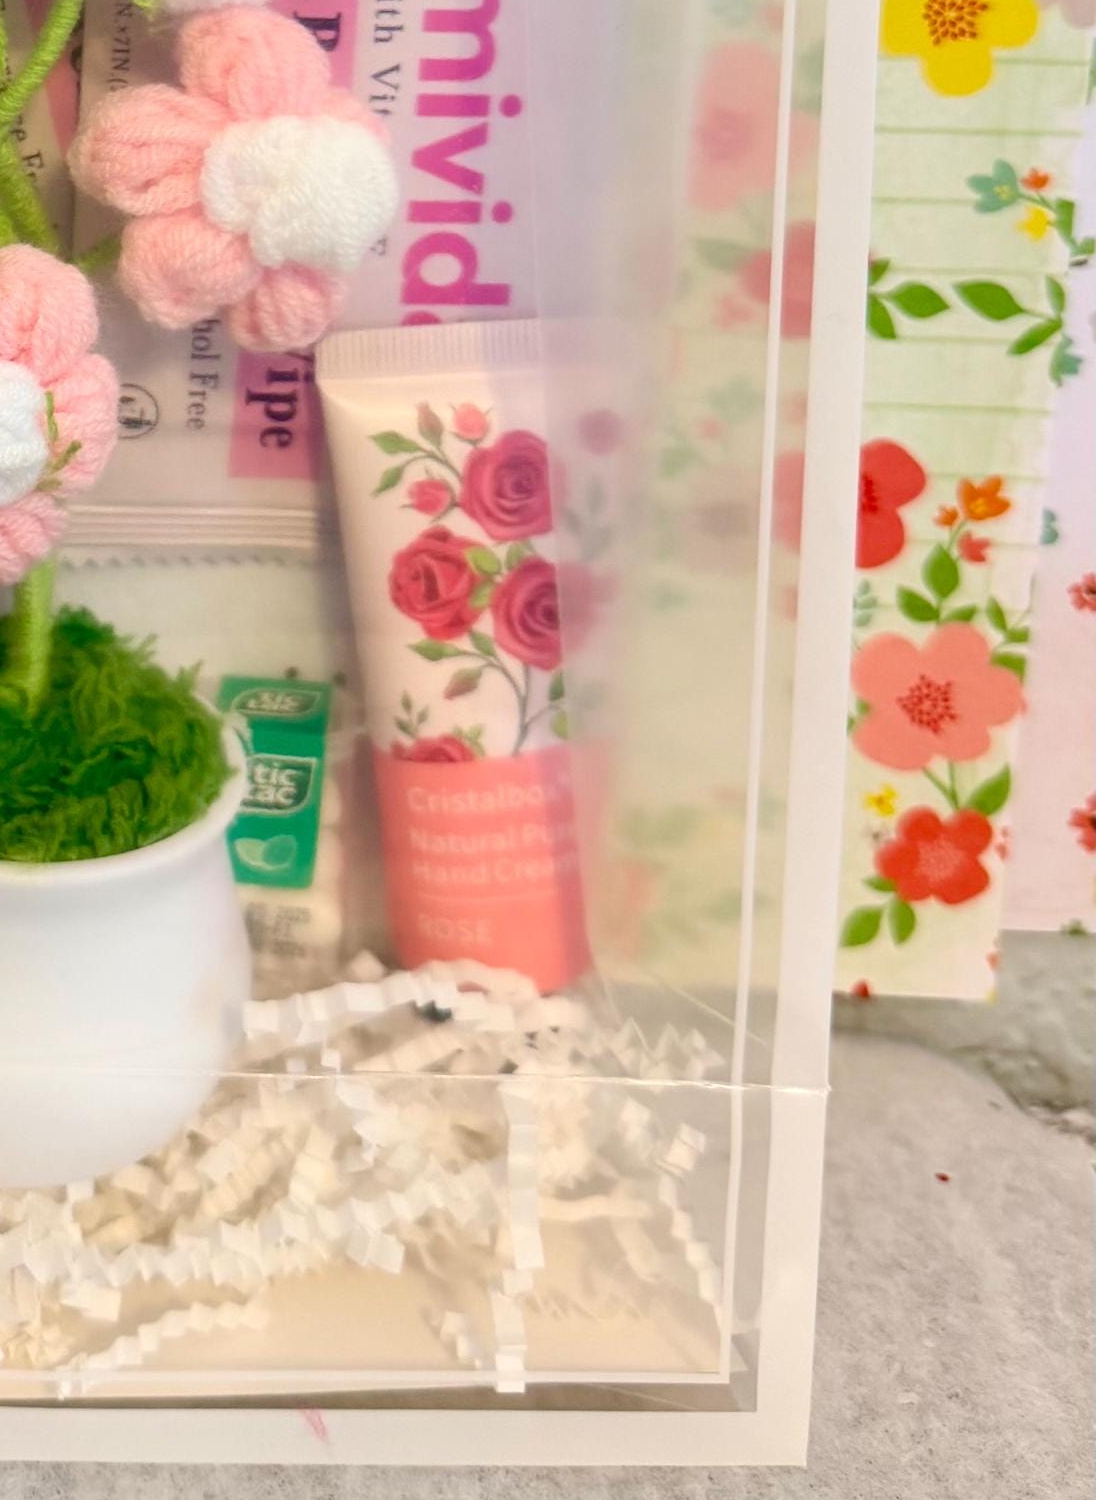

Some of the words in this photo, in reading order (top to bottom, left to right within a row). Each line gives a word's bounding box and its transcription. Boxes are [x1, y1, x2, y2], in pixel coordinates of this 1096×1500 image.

[185, 371, 219, 431] Free
[253, 762, 302, 786] tic
[417, 913, 492, 947] ROSE
